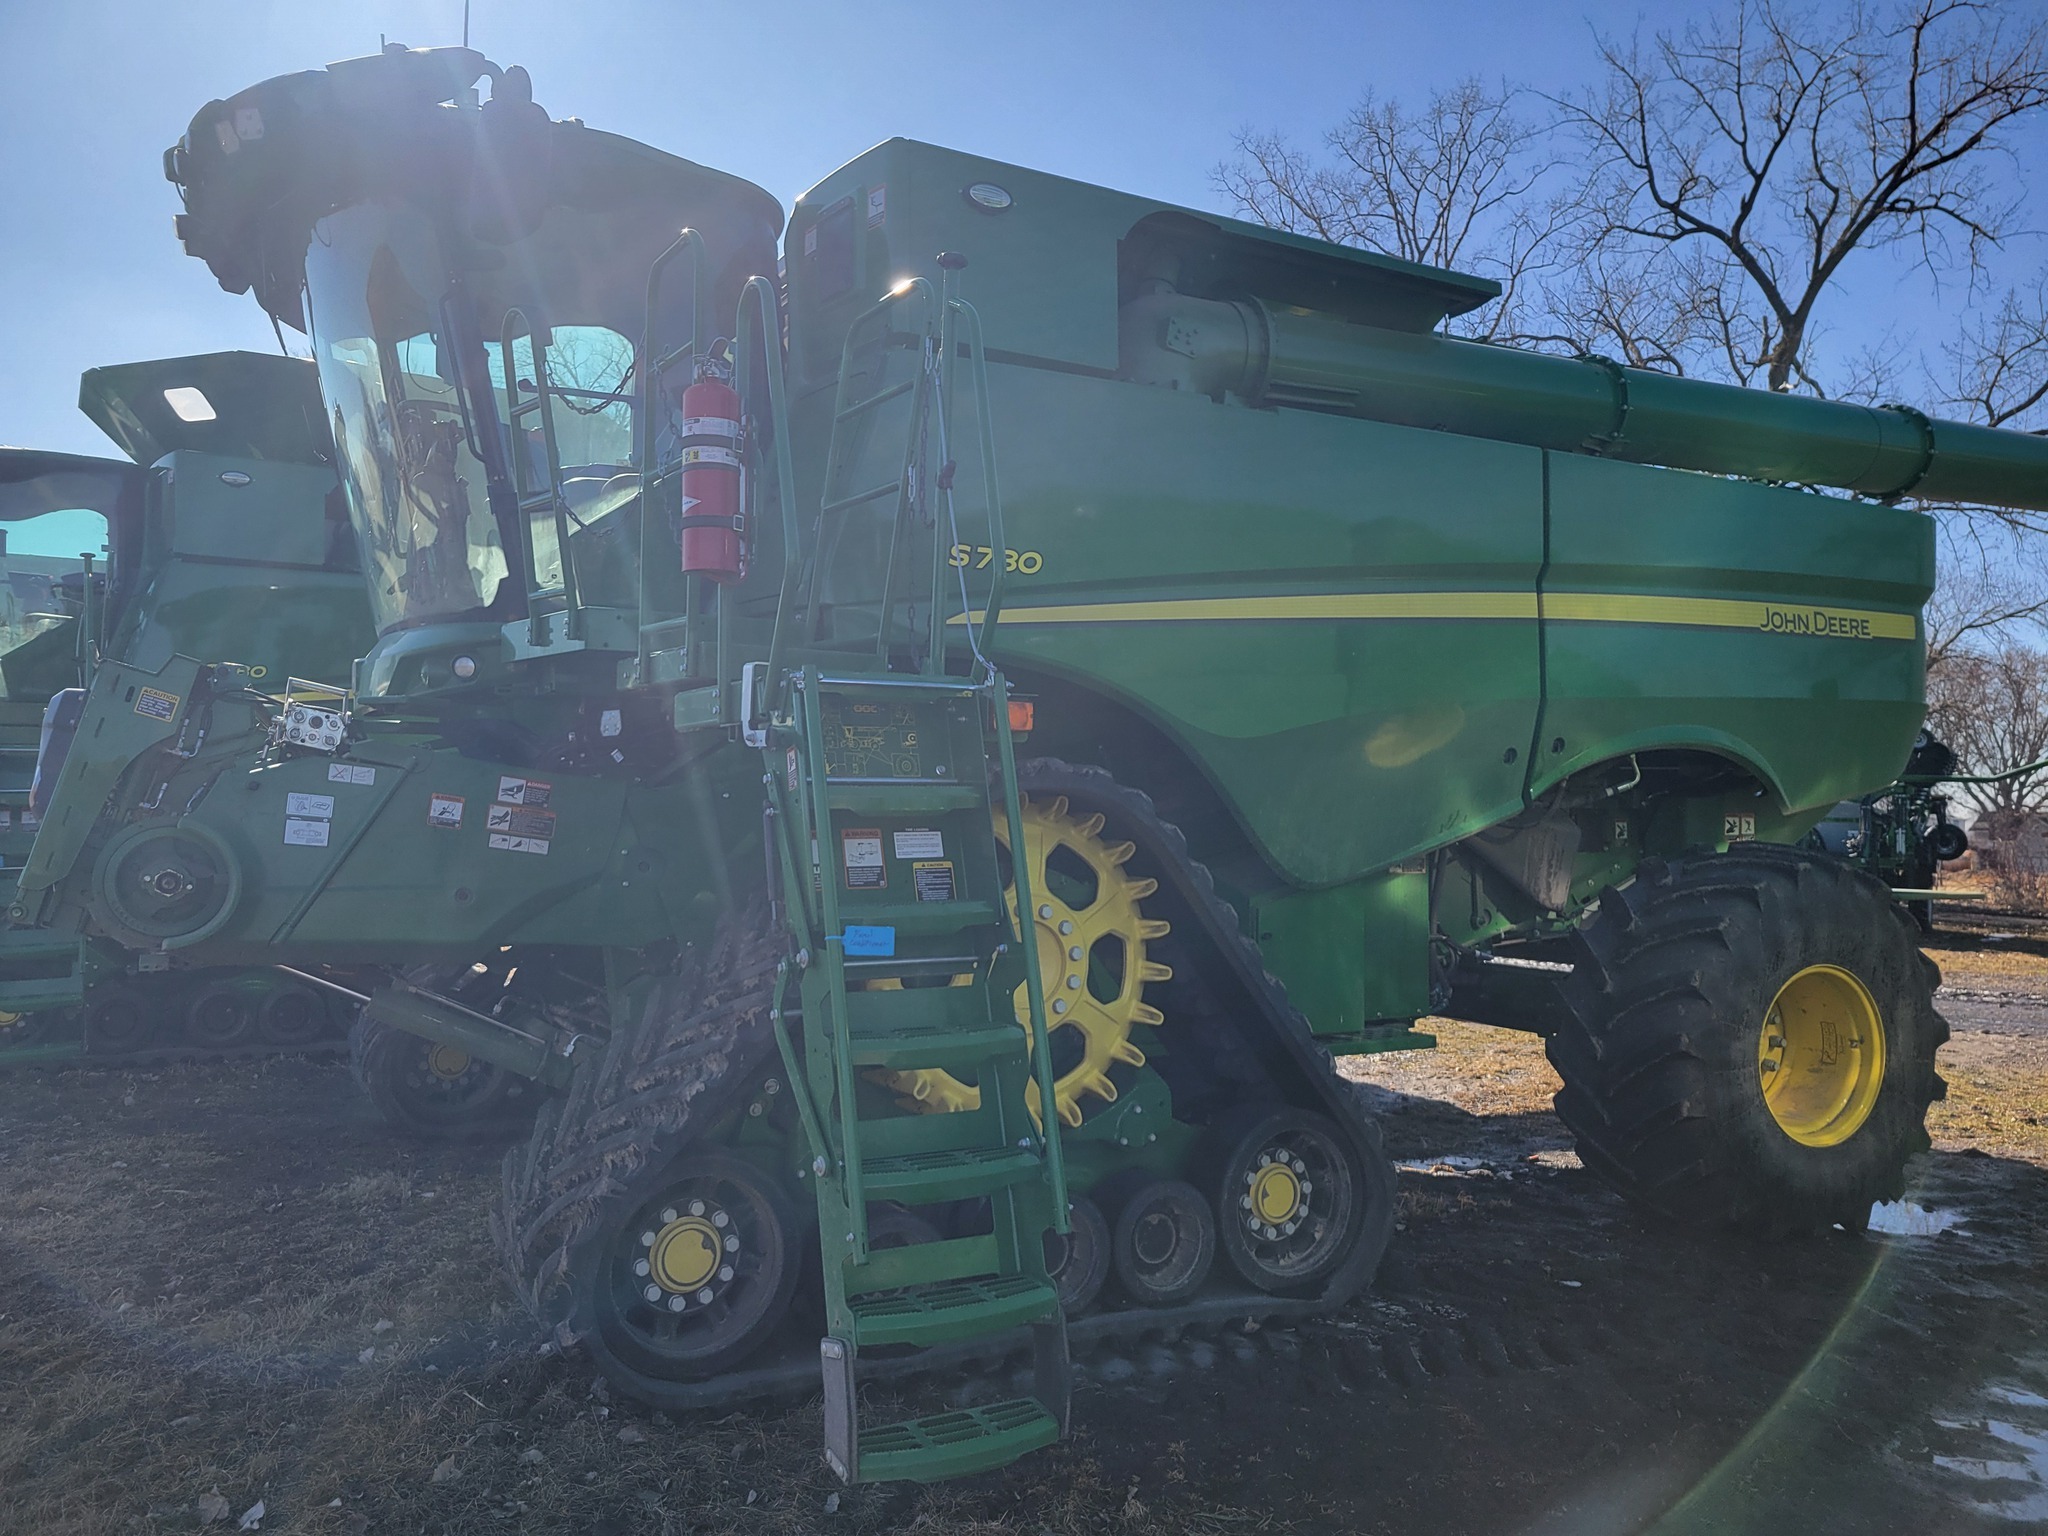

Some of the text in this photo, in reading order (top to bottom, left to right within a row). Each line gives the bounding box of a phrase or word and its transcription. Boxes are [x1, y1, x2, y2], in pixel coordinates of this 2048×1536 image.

[1760, 607, 1871, 636] JOHN DEERE
[148, 689, 178, 702] CAUTION
